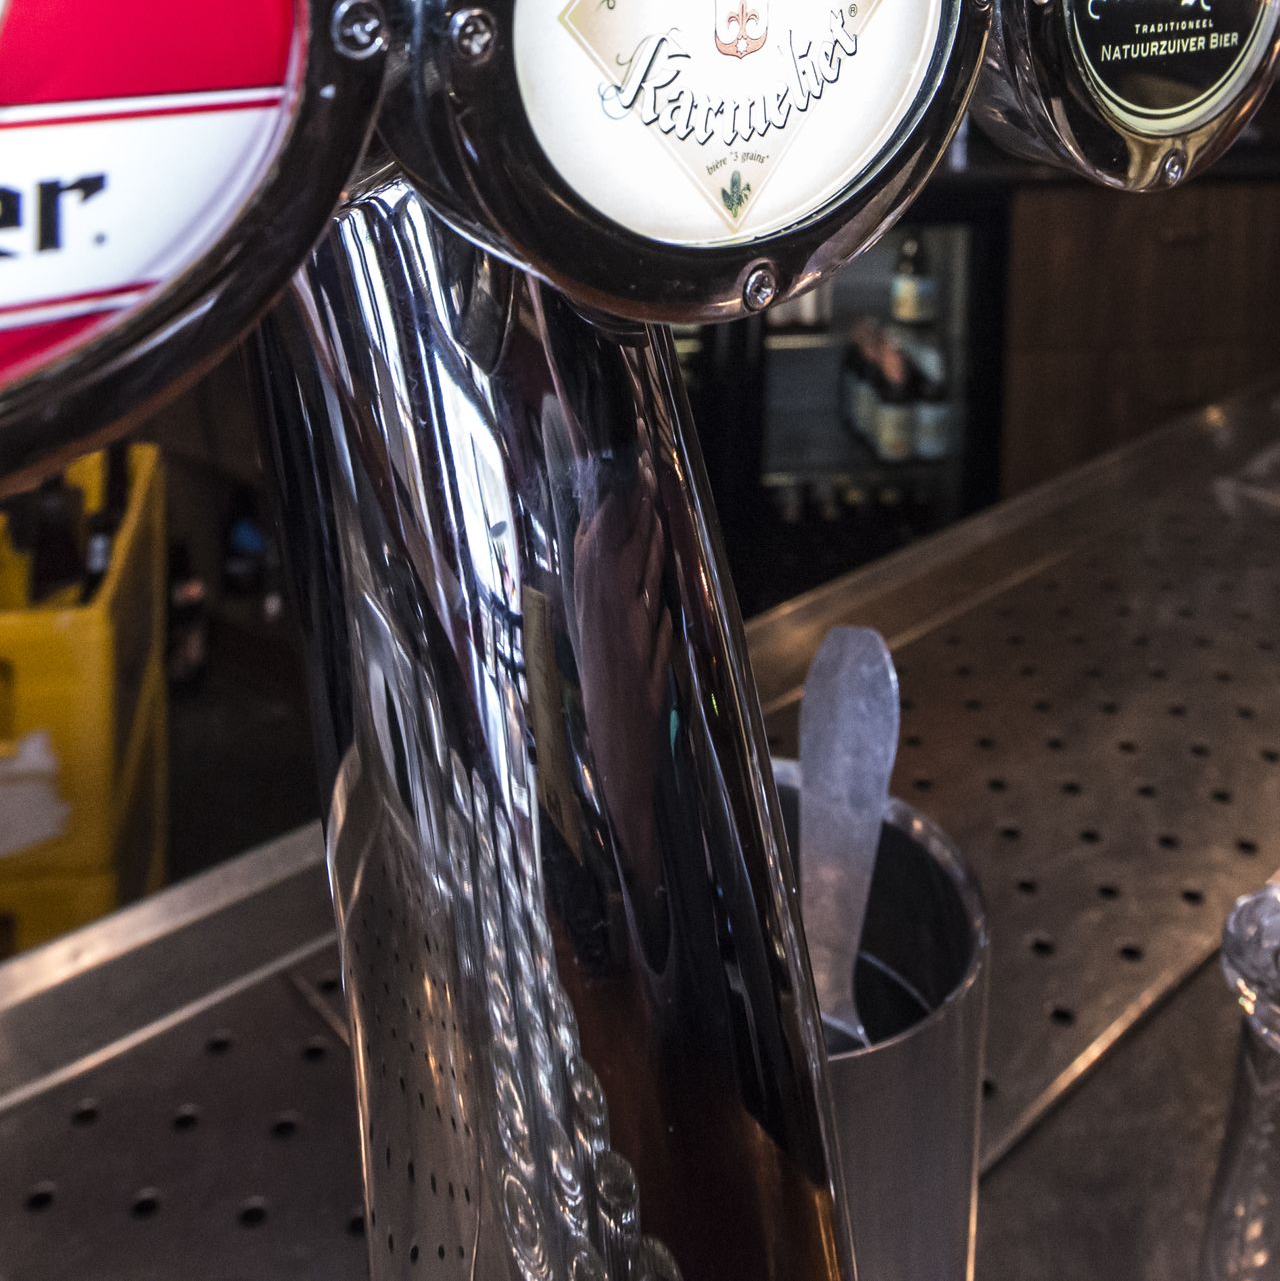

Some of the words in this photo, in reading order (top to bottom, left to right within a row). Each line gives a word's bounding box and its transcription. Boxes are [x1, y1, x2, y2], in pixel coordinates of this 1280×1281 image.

[1134, 19, 1214, 35] TRADITIONEEL
[1100, 36, 1206, 63] NATUURZUIVER
[1209, 32, 1240, 51] BIER
[598, 8, 858, 146] Karmeliet
